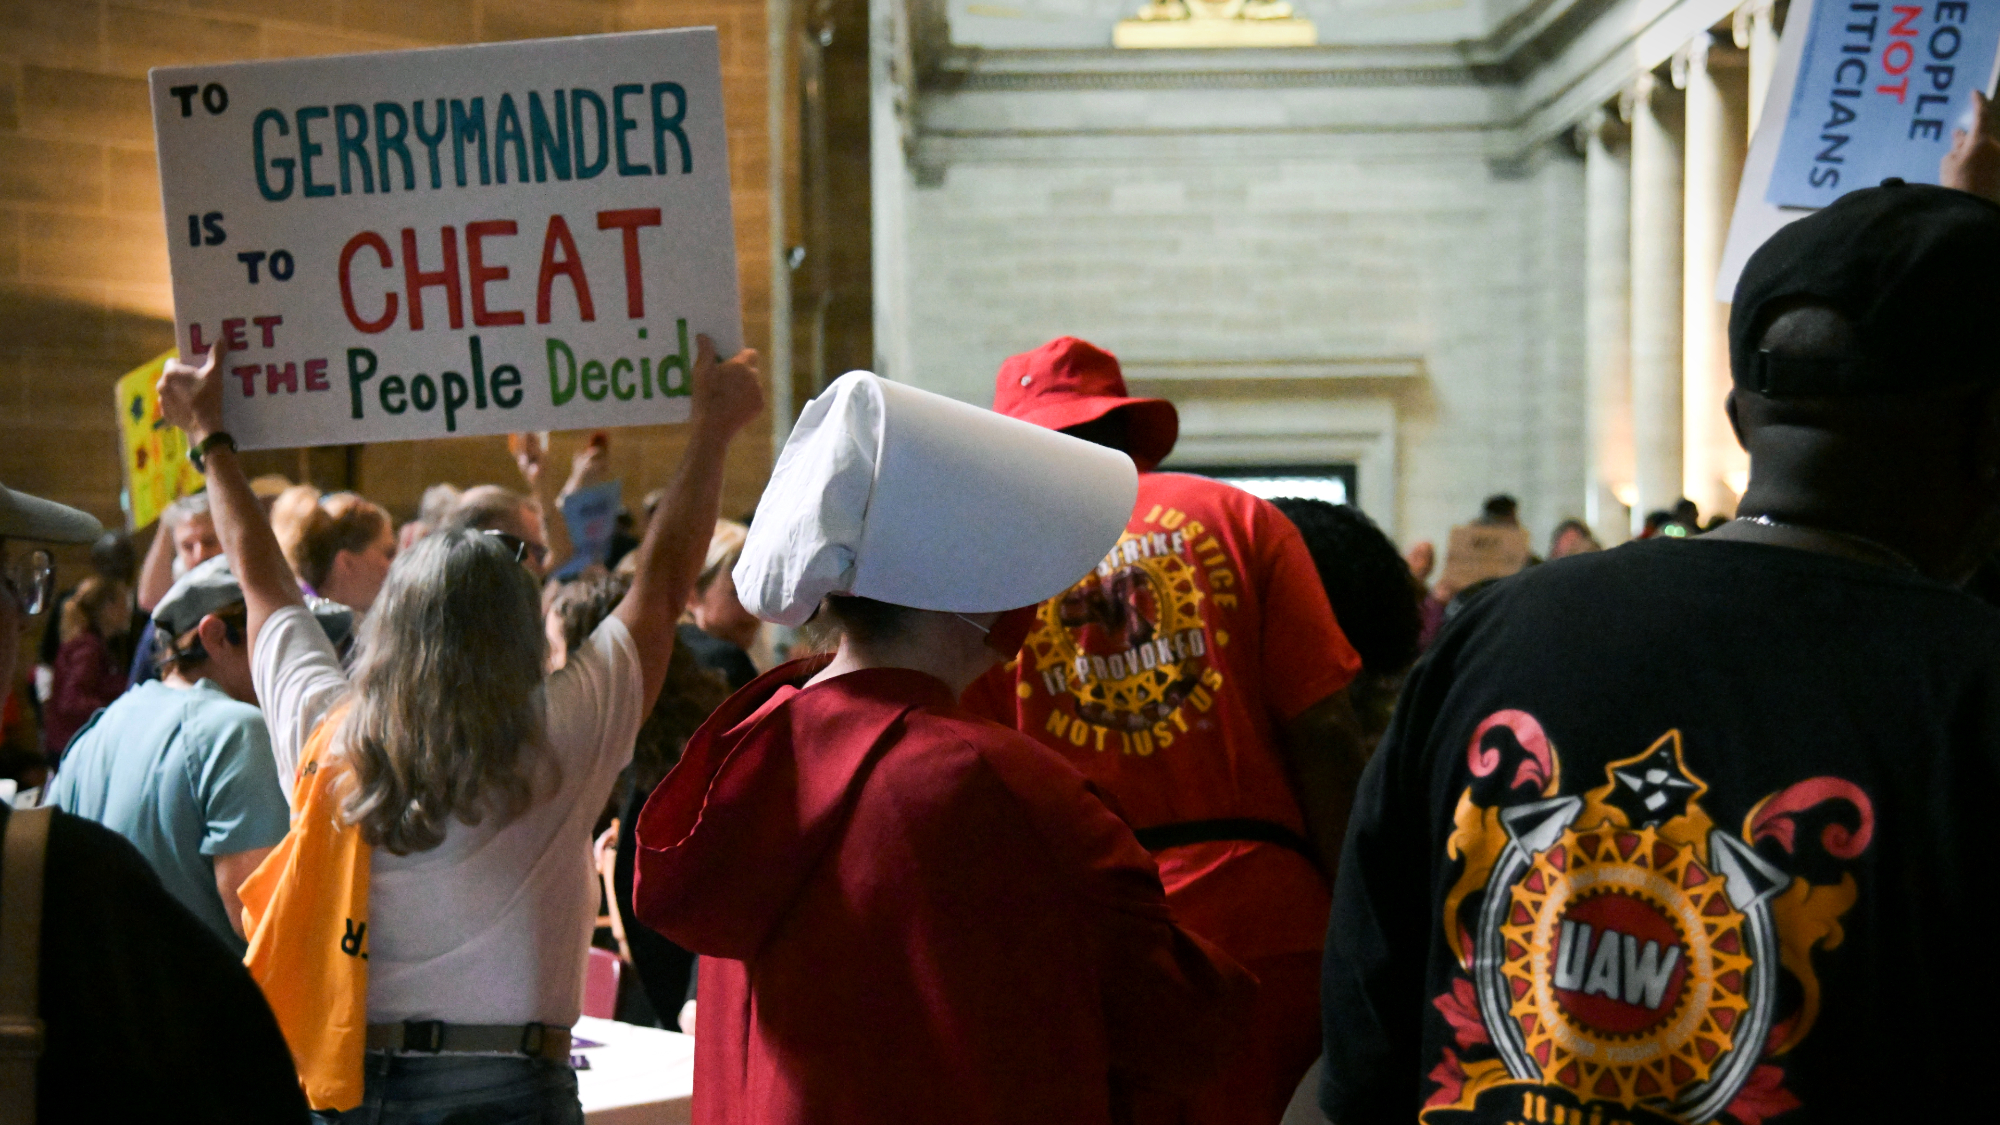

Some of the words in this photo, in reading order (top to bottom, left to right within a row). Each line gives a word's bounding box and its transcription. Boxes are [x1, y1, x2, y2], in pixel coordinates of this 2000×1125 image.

[1875, 5, 1923, 105] NOT
[170, 83, 229, 118] TO
[252, 82, 693, 202] GERRYMANDER
[189, 212, 227, 247] IS
[238, 249, 295, 285] TO
[338, 208, 662, 334] CHEAT
[189, 314, 284, 355] LET
[231, 358, 331, 398] THE
[347, 336, 524, 432] People
[546, 318, 723, 407] Decid
[1143, 504, 1238, 610] JUSTICE
[1074, 628, 1206, 684] PROVOKED
[1046, 709, 1108, 752] NOT
[1121, 706, 1189, 756] JUST
[1188, 667, 1223, 712] US
[1553, 918, 1681, 1010] UAW
